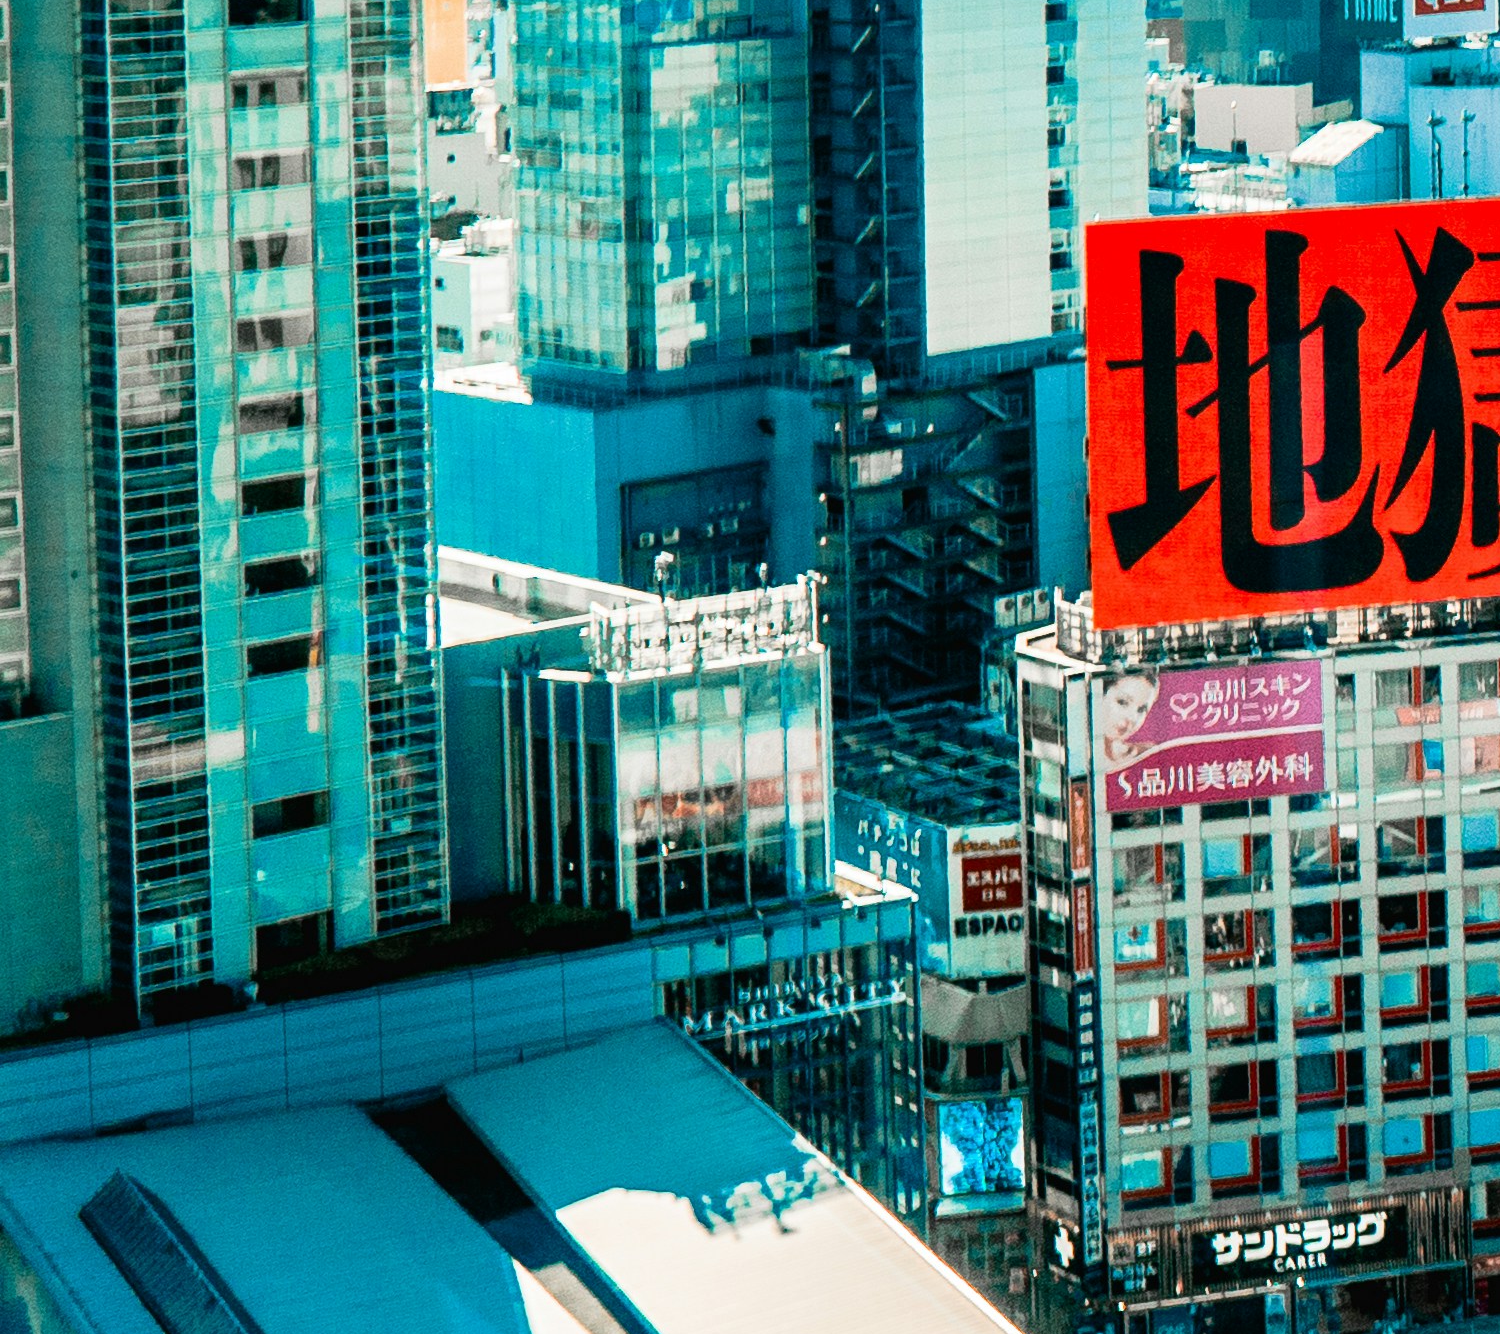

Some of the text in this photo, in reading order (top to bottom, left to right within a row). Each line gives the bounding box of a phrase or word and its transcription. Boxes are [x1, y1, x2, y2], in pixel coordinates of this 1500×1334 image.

[1200, 672, 1312, 704] 品川スキン
[1200, 696, 1301, 729] クリニック
[1137, 750, 1314, 799] 品川美容外科
[966, 865, 1022, 888] エスパス
[1211, 1211, 1388, 1266] サンドラッグ
